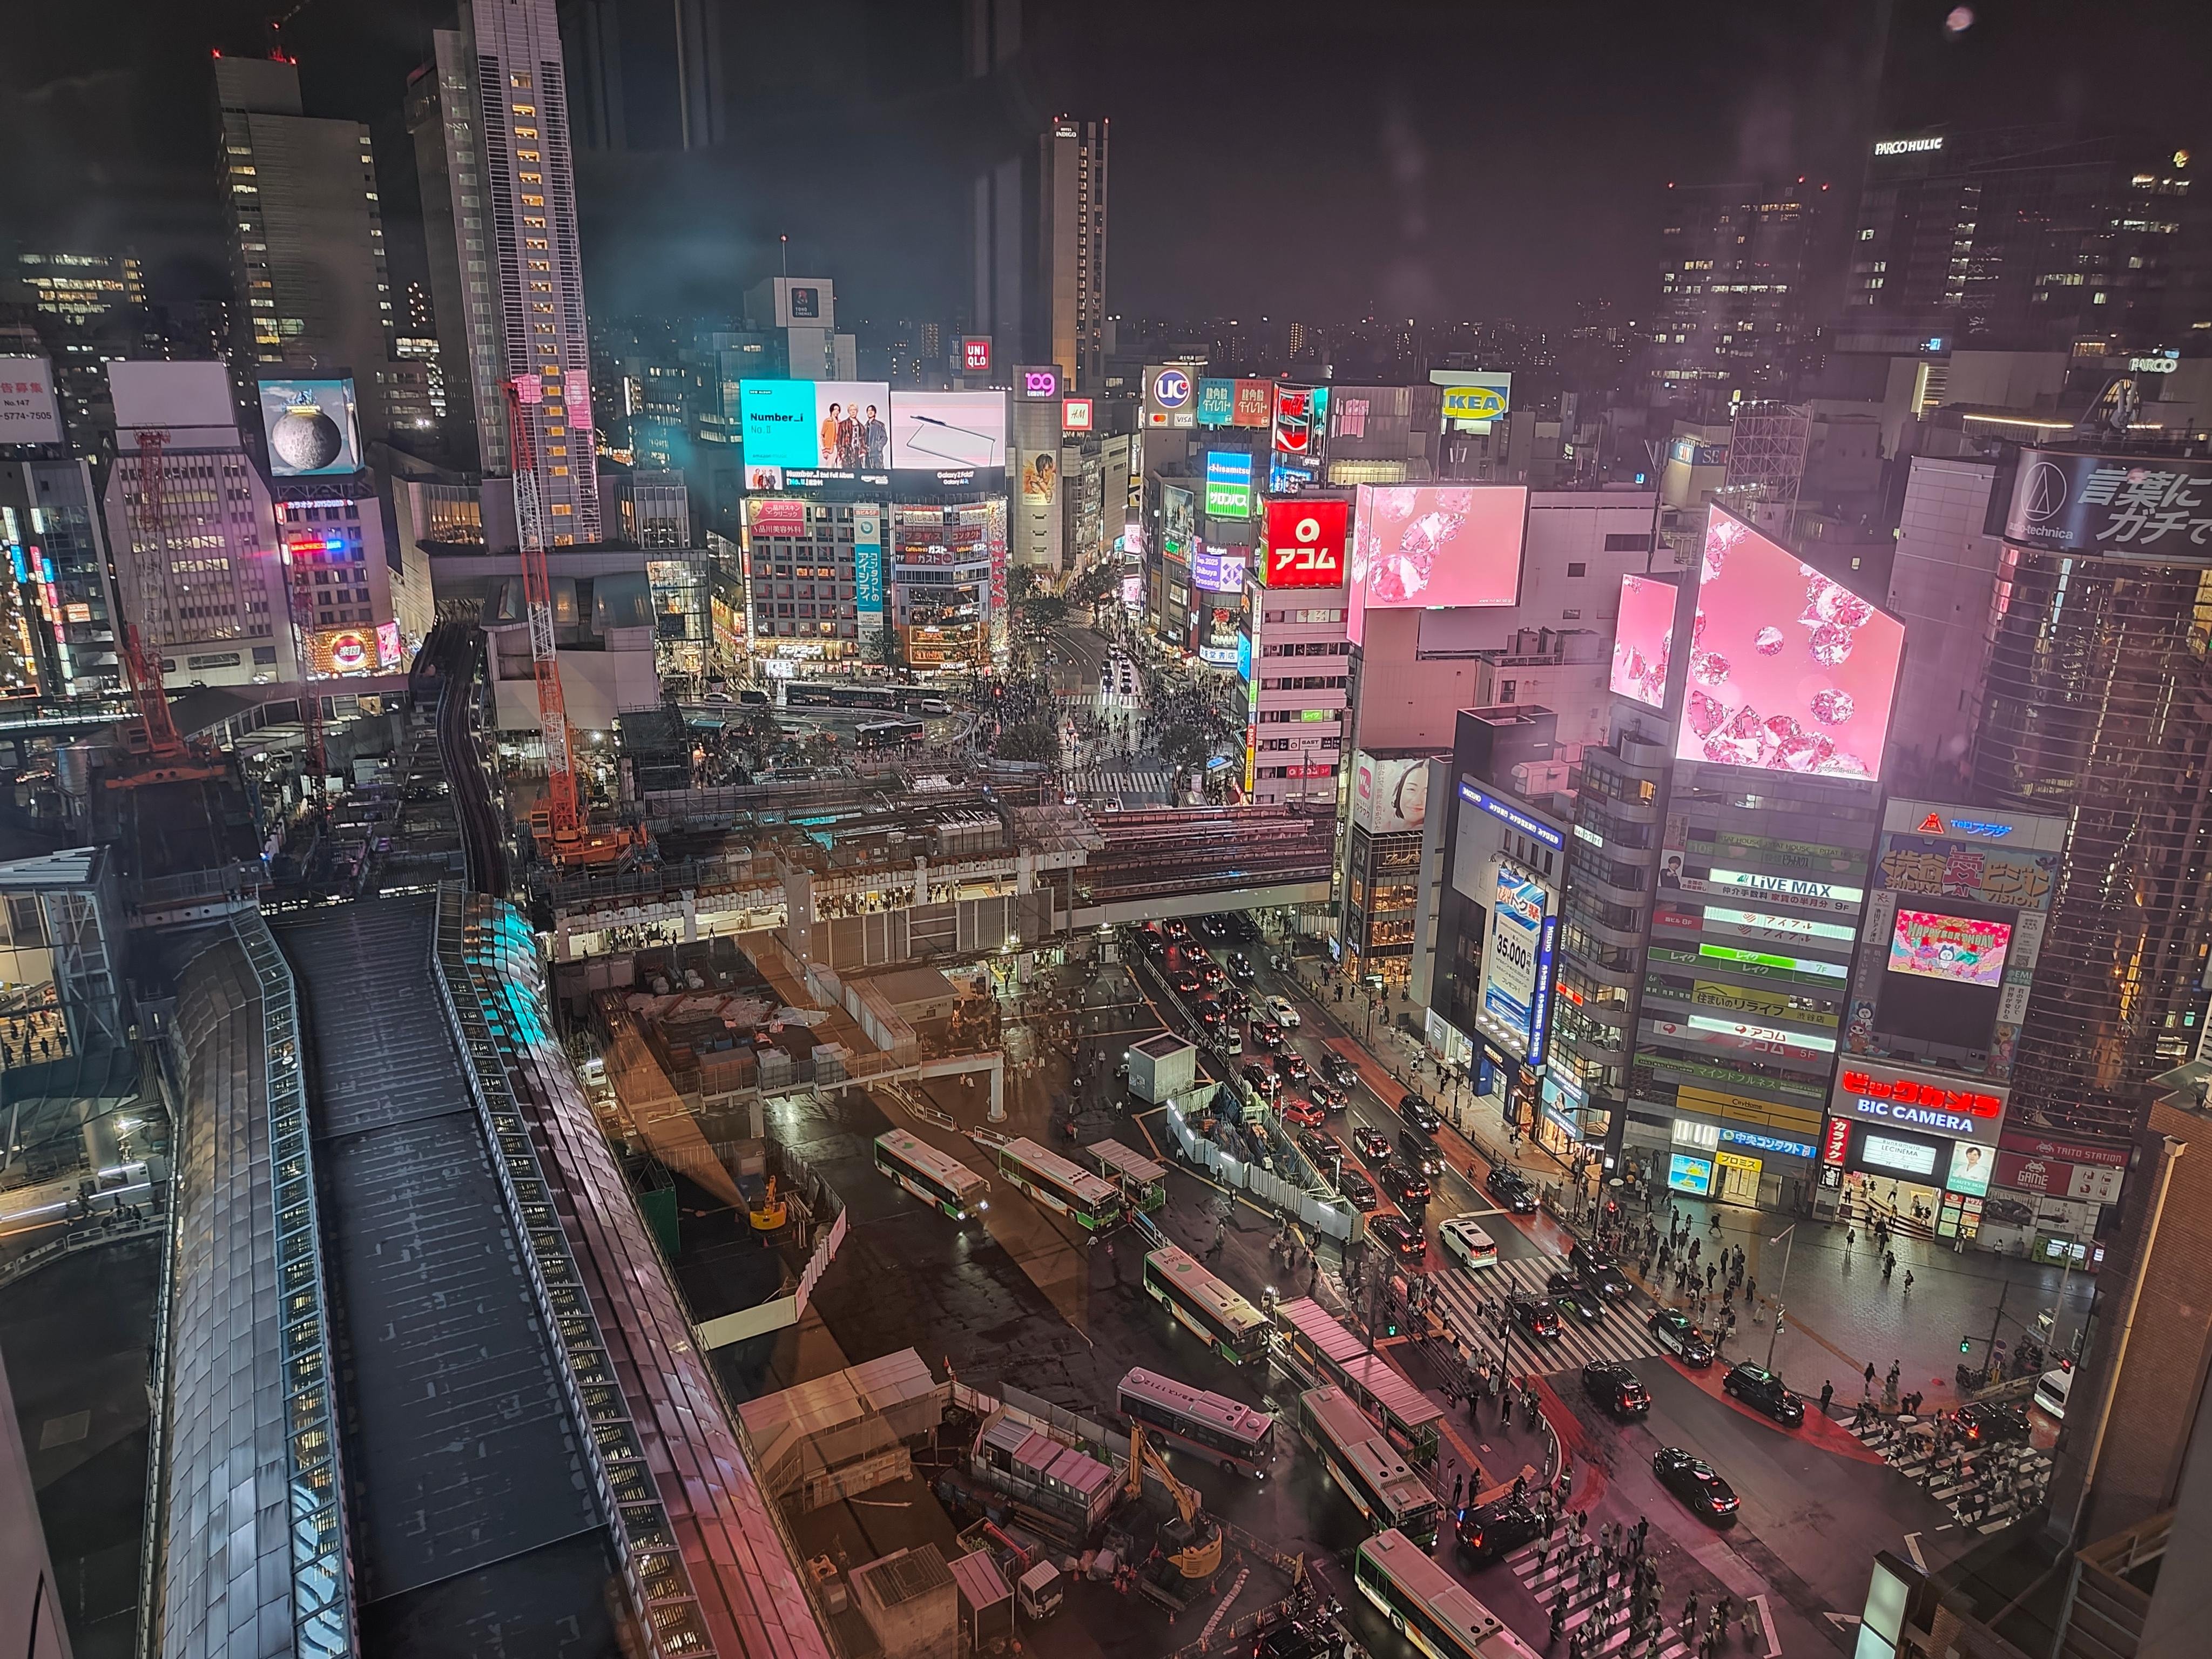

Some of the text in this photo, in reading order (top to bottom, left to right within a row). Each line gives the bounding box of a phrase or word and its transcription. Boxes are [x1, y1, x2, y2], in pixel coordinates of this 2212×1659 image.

[1875, 137, 1943, 155] PARCO HULIC
[967, 345, 984, 355] UNI
[949, 355, 962, 370] PRIDE
[967, 356, 986, 367] QLO
[2130, 359, 2177, 373] PARCO
[1025, 373, 1055, 397] 109
[1158, 380, 1188, 399] UC
[750, 413, 804, 422] Number_i
[1210, 493, 1247, 506] サロンパス
[758, 525, 801, 534] 品川美容外科
[2009, 522, 2073, 539] audio-technica
[928, 545, 947, 554] ガスト
[973, 543, 987, 551] ガスト
[918, 554, 940, 563] ガスト
[1275, 548, 1336, 570] アコム
[858, 552, 869, 602] アイシティ
[869, 552, 880, 602] コンタクトの
[1196, 567, 1217, 577] Shibuya
[1196, 577, 1220, 589] Crossing
[1211, 634, 1238, 644] DMM
[339, 645, 361, 657] 楽園
[1786, 844, 1811, 852] HOUSE
[1791, 881, 1831, 897] MAX
[1885, 878, 1943, 894] SHIBUYA
[1953, 886, 1970, 897] AI
[1723, 886, 1850, 911] 仲介手数料 家賃の半月分 9F
[1987, 892, 2040, 908] VISION
[1907, 921, 1939, 938] HAPPY
[1545, 926, 1554, 952] MIZUHO
[1670, 952, 1696, 963] レイク
[1736, 951, 1827, 974] レイク 7F
[1742, 963, 1770, 975] レイク
[1697, 993, 1825, 1023] 住まいのリライフ 渋谷店
[1750, 1027, 1786, 1042] アコム
[1738, 1037, 1815, 1058] アコム 5F
[1698, 1067, 1776, 1089] マインドフルネス
[1635, 1089, 1645, 1097] 3F
[1843, 1070, 2000, 1118] ビックカメラ
[1857, 1098, 1974, 1132] BIC CAMERA
[1735, 1133, 1800, 1155] 中央コンタクト
[1828, 1121, 1847, 1159] カラオケ
[1721, 1154, 1756, 1168] プロミス
[2056, 1146, 2122, 1163] TAITO STATION
[1950, 1178, 1971, 1186] BEAUTY
[2018, 1170, 2049, 1186] GAME
[1144, 1380, 1166, 1392] 1712
